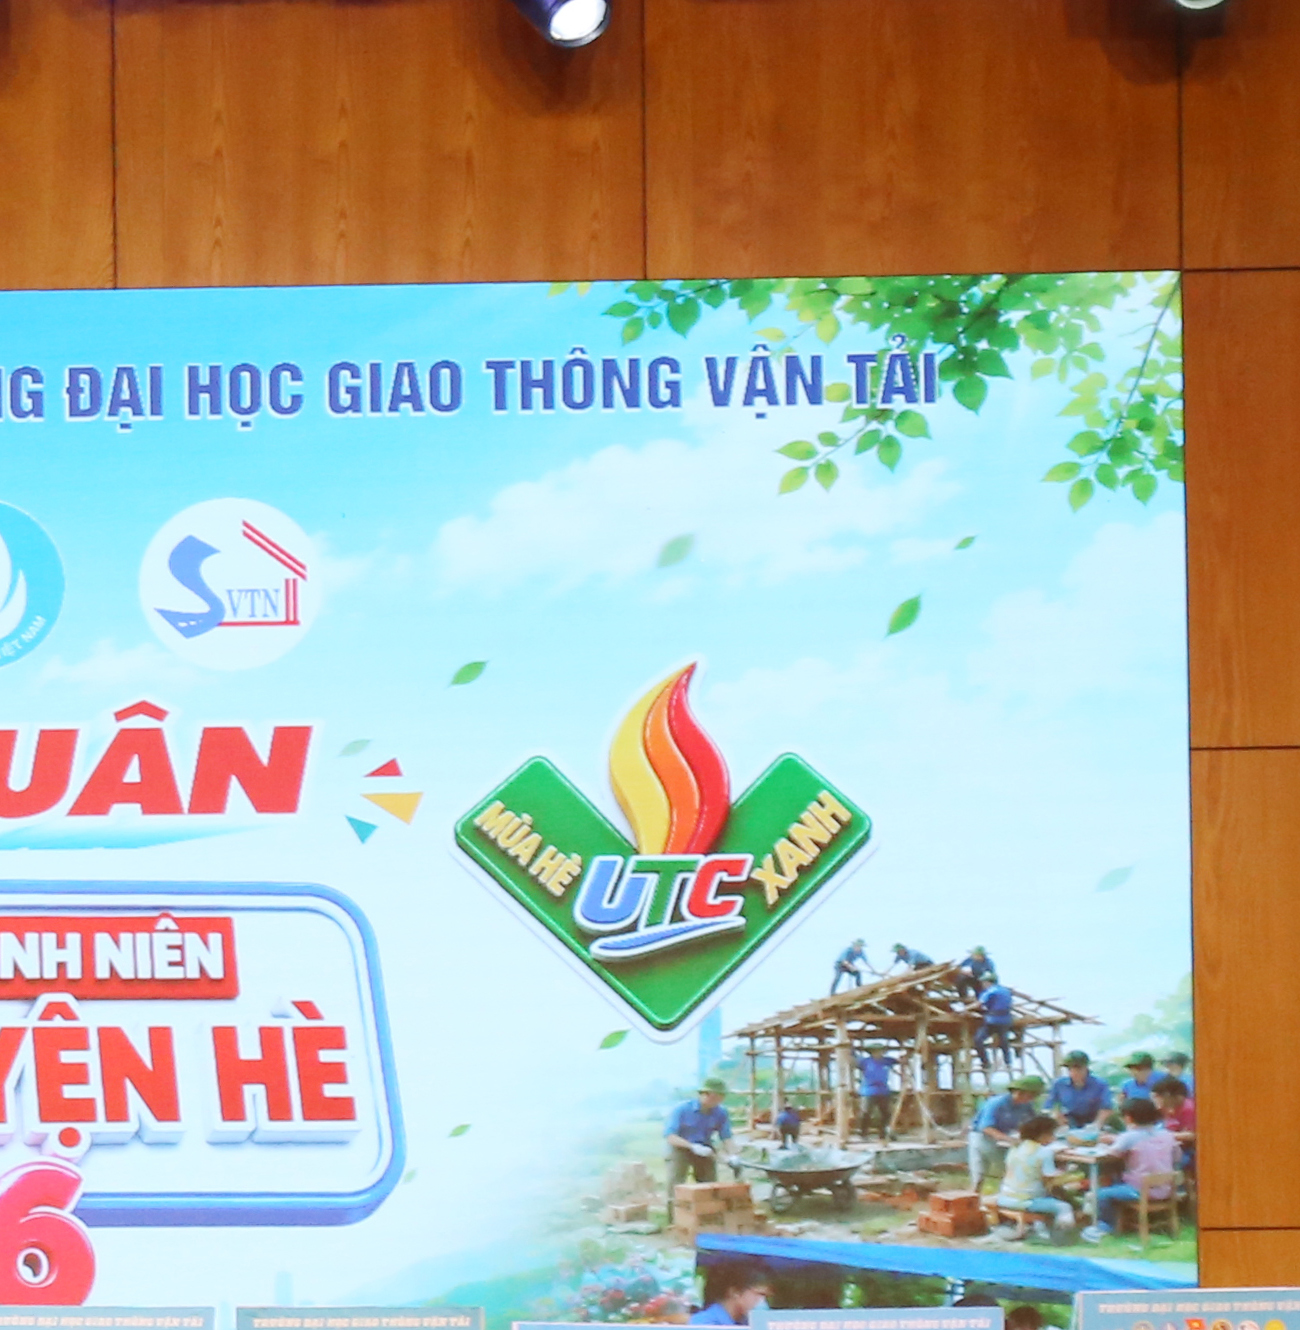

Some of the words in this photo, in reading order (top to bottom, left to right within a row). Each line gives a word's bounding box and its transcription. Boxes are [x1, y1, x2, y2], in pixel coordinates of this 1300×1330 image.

[66, 364, 163, 431] ĐẠI
[187, 362, 304, 429] HỌC
[327, 360, 458, 415] GIAO
[485, 347, 683, 413] THÔNG
[707, 343, 825, 421] VẬN
[844, 331, 940, 408] TẢI
[21, 615, 46, 642] NAM
[474, 801, 544, 863] MÙA
[532, 846, 584, 899] HÈ
[574, 854, 754, 931] UTC
[752, 790, 853, 905] XANH
[94, 912, 223, 982] NIÊN
[212, 1000, 357, 1128] HÈ
